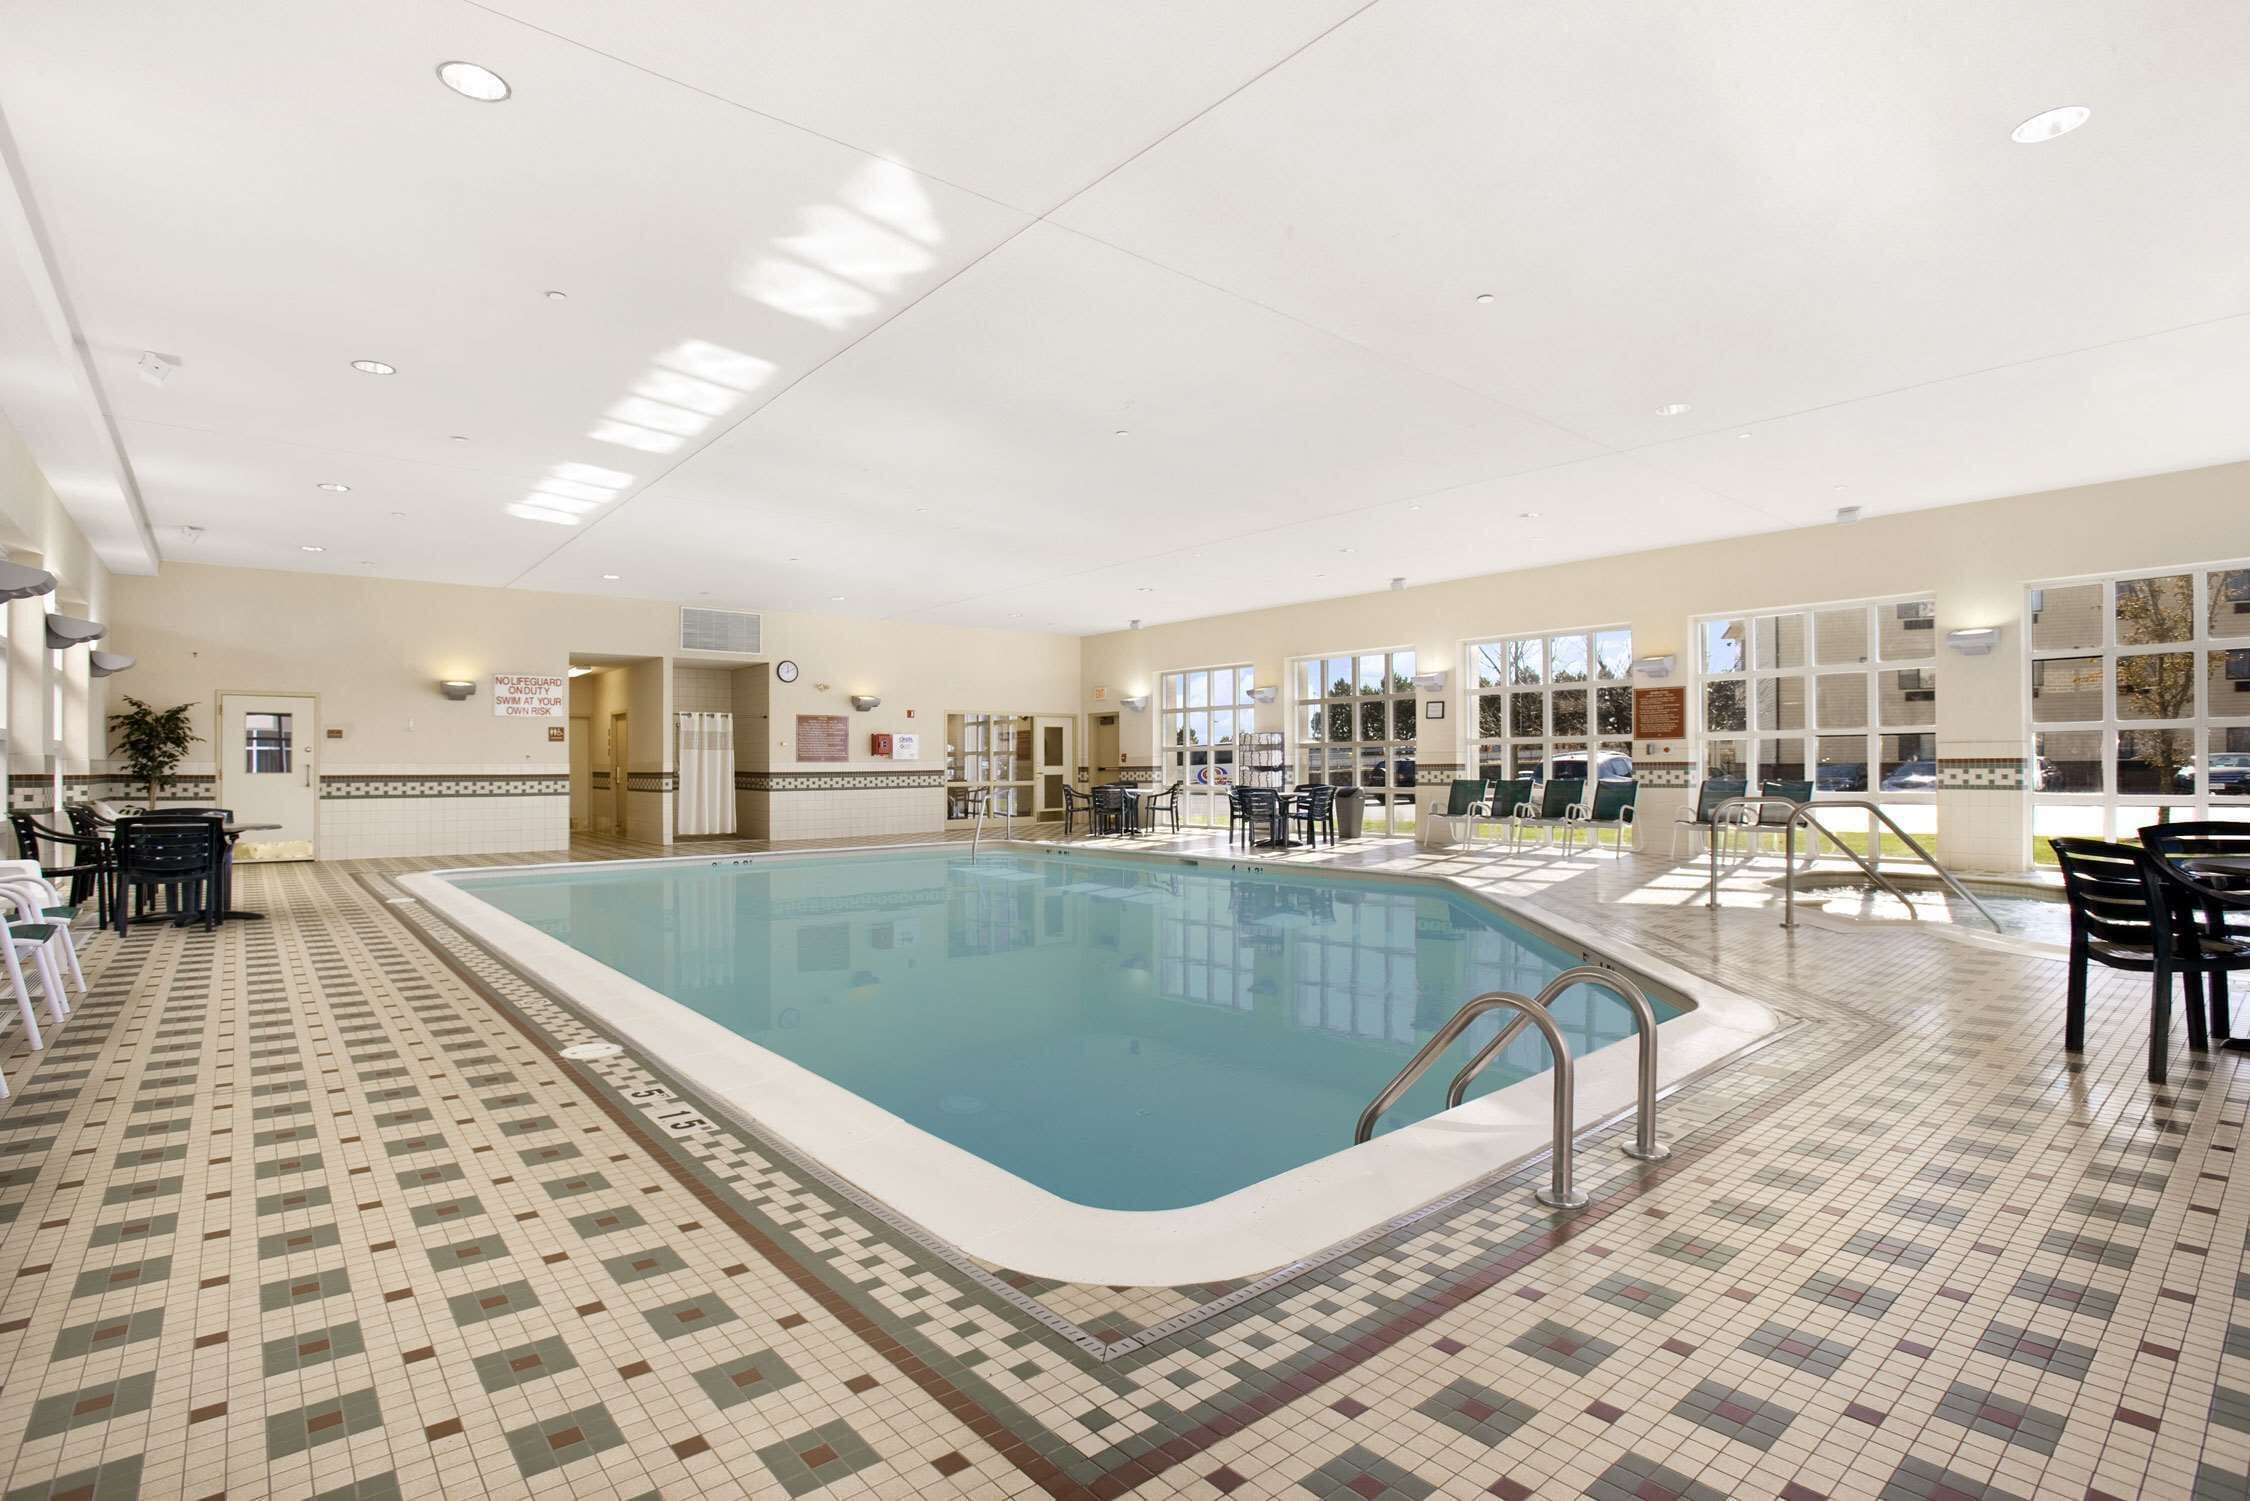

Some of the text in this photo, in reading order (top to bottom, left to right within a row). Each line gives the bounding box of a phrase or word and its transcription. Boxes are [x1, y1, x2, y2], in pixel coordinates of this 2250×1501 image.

[495, 677, 562, 686] NO LIFEGUARD
[508, 686, 550, 695] ON DUTY
[496, 696, 562, 706] SWIM AT YOUR
[506, 706, 551, 715] OWN RISK
